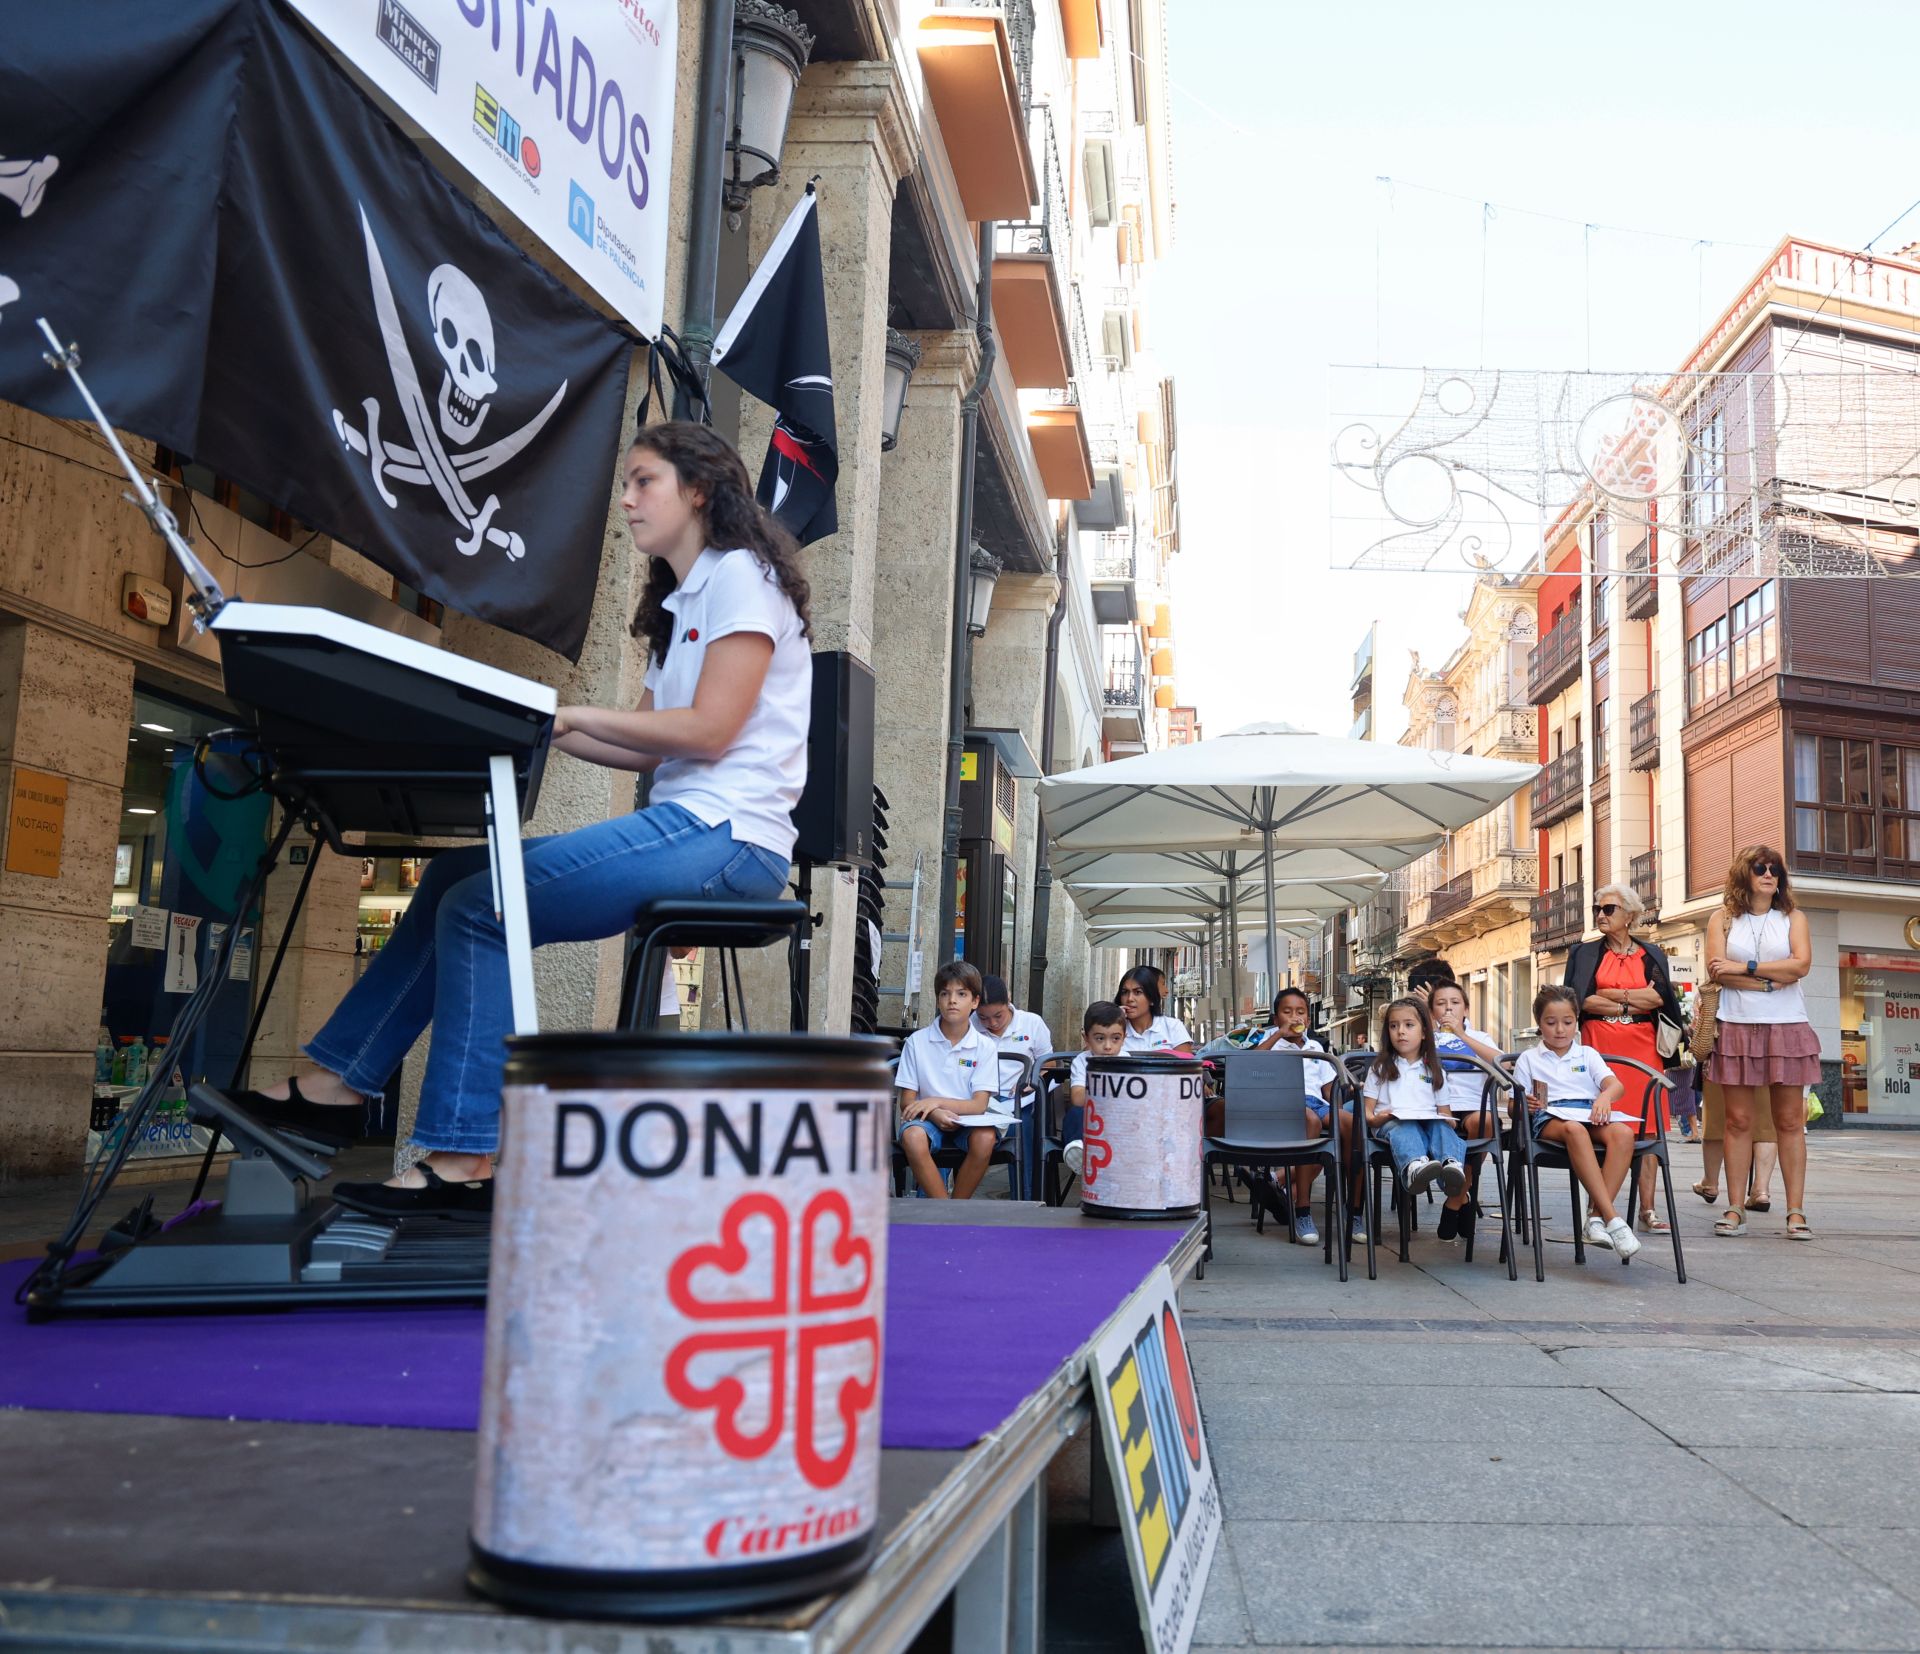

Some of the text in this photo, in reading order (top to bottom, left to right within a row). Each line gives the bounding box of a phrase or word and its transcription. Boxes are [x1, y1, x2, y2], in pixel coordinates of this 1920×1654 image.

[384, 0, 435, 62] Minute
[597, 216, 636, 265] Diputación
[597, 235, 645, 292] DE PALENCIA
[17, 815, 58, 834] NOTARIO
[1673, 965, 1692, 973] Lowi
[1885, 1001, 1920, 1019] Bien
[1885, 1078, 1911, 1095] Hola
[138, 1116, 192, 1143] venida
[704, 1504, 859, 1559] Cáritas
